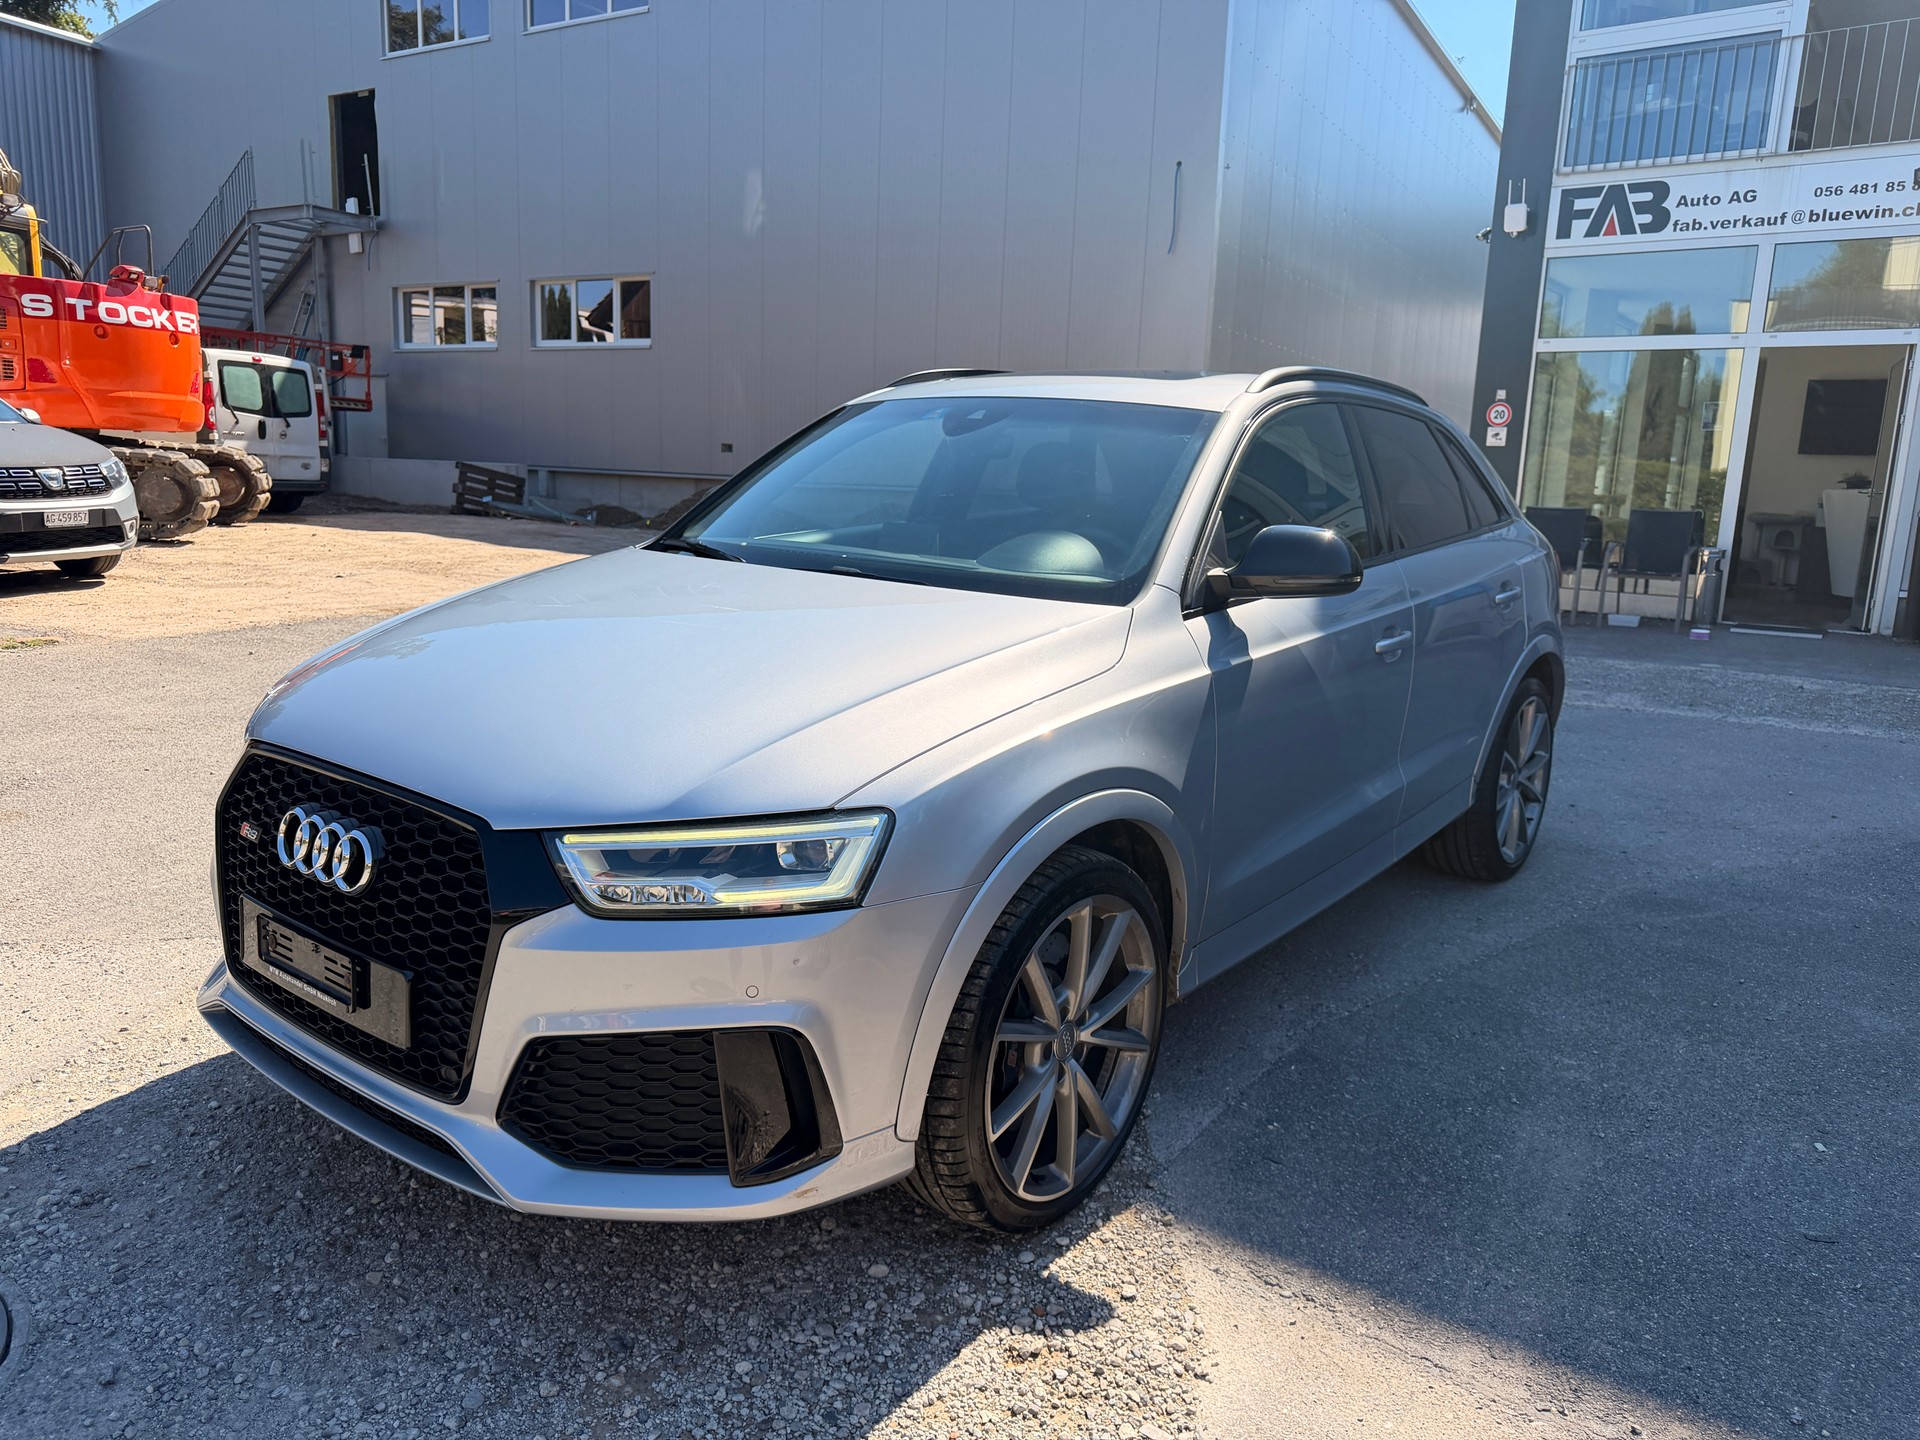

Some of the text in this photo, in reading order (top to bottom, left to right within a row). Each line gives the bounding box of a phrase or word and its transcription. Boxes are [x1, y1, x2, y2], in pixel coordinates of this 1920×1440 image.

[1675, 189, 1757, 209] Auto AG
[1814, 185, 1844, 198] 056
[1849, 182, 1878, 195] 481
[1885, 180, 1906, 193] 85
[1556, 180, 1671, 240] FAB
[21, 293, 198, 335] STOCKER
[1493, 409, 1506, 420] 20
